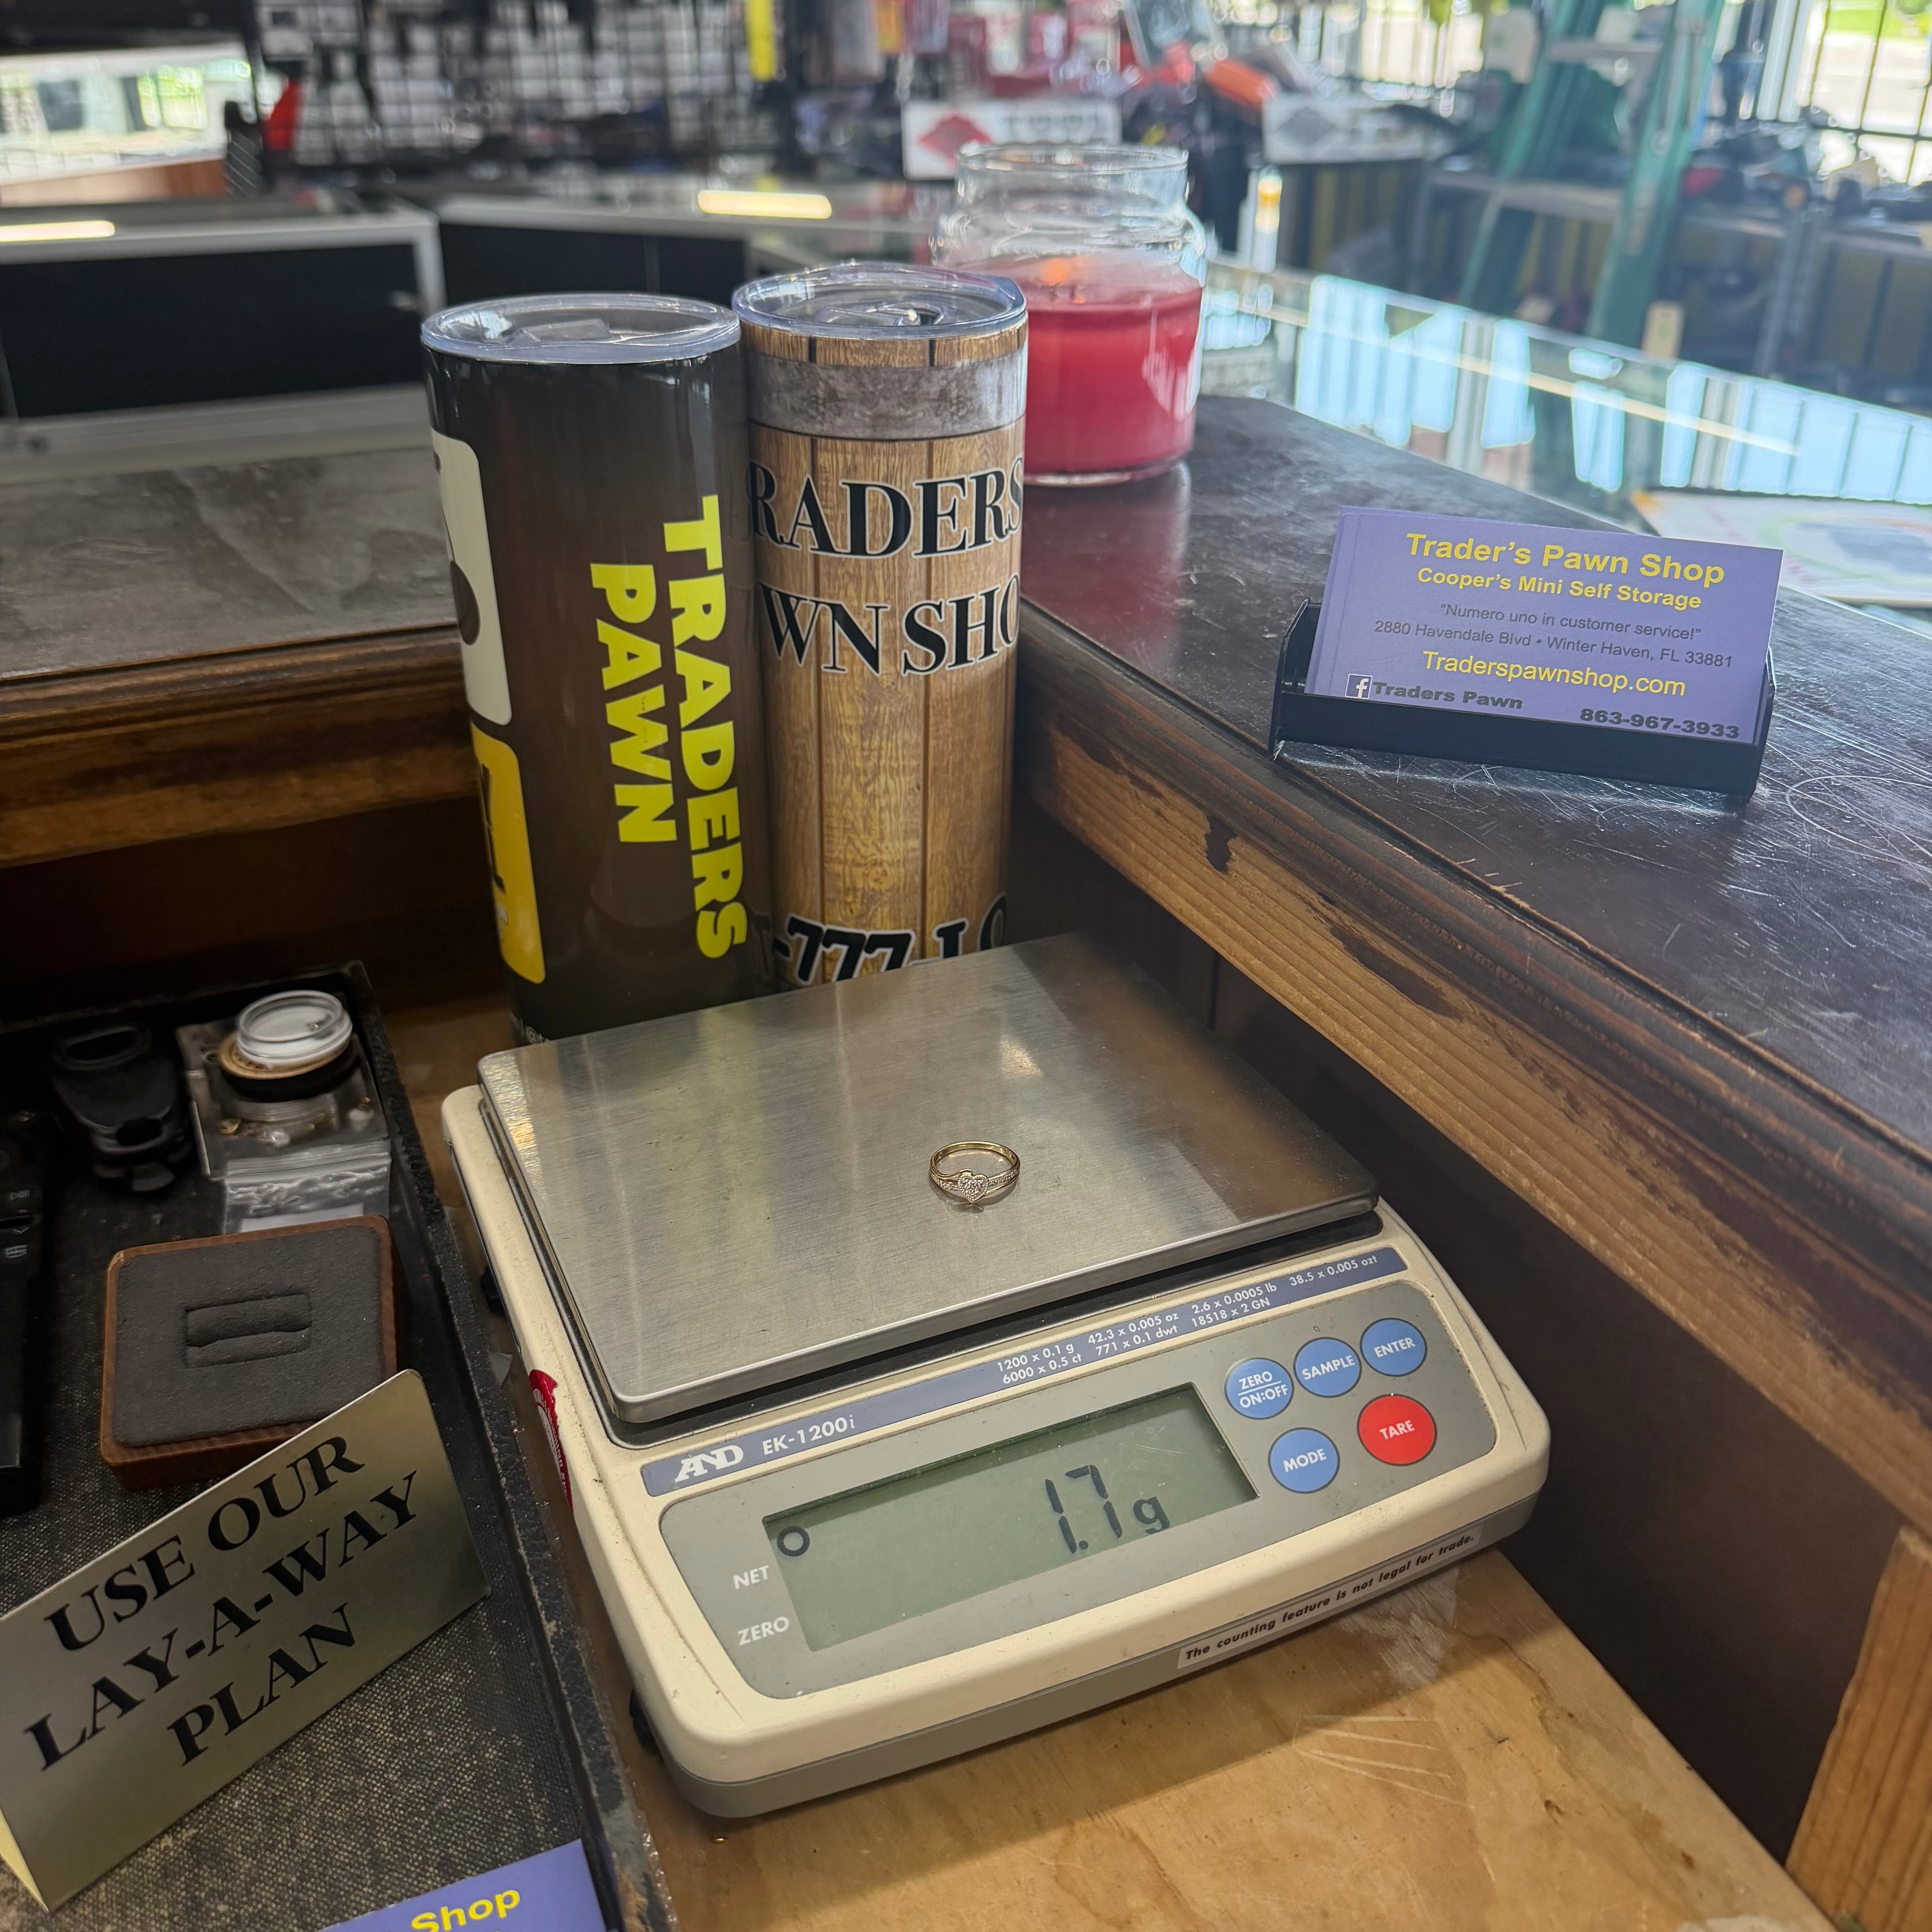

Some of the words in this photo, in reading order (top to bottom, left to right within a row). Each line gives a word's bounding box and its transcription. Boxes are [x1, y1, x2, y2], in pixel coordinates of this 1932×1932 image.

[1407, 533, 1531, 565] Trader’s
[1542, 544, 1628, 574] Pawn
[1640, 554, 1725, 588] Shop
[1417, 568, 1511, 590] Cooper’s
[1518, 576, 1562, 595] Mini
[1569, 581, 1611, 599] Self
[1617, 585, 1701, 610] Storage
[1374, 620, 1411, 635] 2880
[1415, 623, 1494, 644] Havendale
[1499, 632, 1531, 647] Blvd
[1547, 636, 1596, 654] Winter
[1601, 641, 1654, 662] Haven,
[1660, 648, 1680, 663] FL
[1684, 651, 1733, 668] 33881
[1510, 612, 1538, 625] uno
[1542, 613, 1555, 626] in
[1560, 615, 1631, 634] customer
[1422, 651, 1686, 696] Traderspawnshop.com
[590, 562, 677, 843] PAWN
[1372, 681, 1456, 703] Traders
[1463, 691, 1523, 710] Pawn
[663, 495, 747, 959] TRADERS
[1580, 708, 1740, 739] 863-967-3933
[997, 1354, 1028, 1372] 1200
[1032, 1353, 1040, 1362] x
[1042, 1344, 1062, 1358] 0.1
[1066, 1343, 1075, 1354] g
[1088, 1329, 1114, 1344] 42.3
[1117, 1328, 1126, 1336] x
[1129, 1315, 1162, 1332] 0.005
[1165, 1312, 1179, 1322] oz
[1191, 1303, 1211, 1315] 2.6
[1214, 1300, 1222, 1308] x
[1224, 1287, 1263, 1305] 0.0005
[1265, 1283, 1277, 1293] lb
[1289, 1272, 1314, 1286] 38.5
[1317, 1270, 1325, 1278] x
[1327, 1259, 1358, 1276] 0.005
[1361, 1255, 1378, 1266] ozt
[1003, 1366, 1034, 1385] 6000
[1038, 1365, 1046, 1374] x
[1049, 1356, 1068, 1371] 0.5
[1072, 1353, 1082, 1363] ct
[1095, 1342, 1118, 1356] 771
[1122, 1340, 1131, 1348] x
[1133, 1331, 1151, 1345] 0.1
[1155, 1325, 1178, 1338] dwt
[1191, 1310, 1228, 1328] 18518
[1231, 1308, 1239, 1317] x
[1243, 1303, 1250, 1314] 2
[1251, 1297, 1271, 1310] GN
[1374, 1337, 1416, 1358] ENTER
[1239, 1371, 1273, 1390] ZERO
[1302, 1354, 1355, 1380] SAMPLE
[1239, 1384, 1289, 1409] ON:OFF
[762, 1414, 856, 1456] EK-1200i
[1379, 1419, 1415, 1440] TARE
[1283, 1448, 1327, 1473] MODE
[1045, 1465, 1122, 1554] 1.7
[1133, 1496, 1170, 1535] g
[43, 1534, 196, 1652] USE
[207, 1435, 366, 1552] OUR
[733, 1565, 770, 1589] NET
[1185, 1644, 1211, 1660] The
[1216, 1618, 1276, 1649] counting
[1281, 1595, 1331, 1623] feature
[1336, 1588, 1347, 1600] is
[1352, 1577, 1374, 1593] not
[1378, 1560, 1411, 1583] legal
[1415, 1553, 1434, 1567] for
[1438, 1535, 1474, 1555] trade.
[24, 1470, 419, 1772] LAY-A-WAY
[738, 1616, 790, 1646] ZERO
[167, 1602, 357, 1767] PLAN
[411, 1889, 521, 1932] Shop
